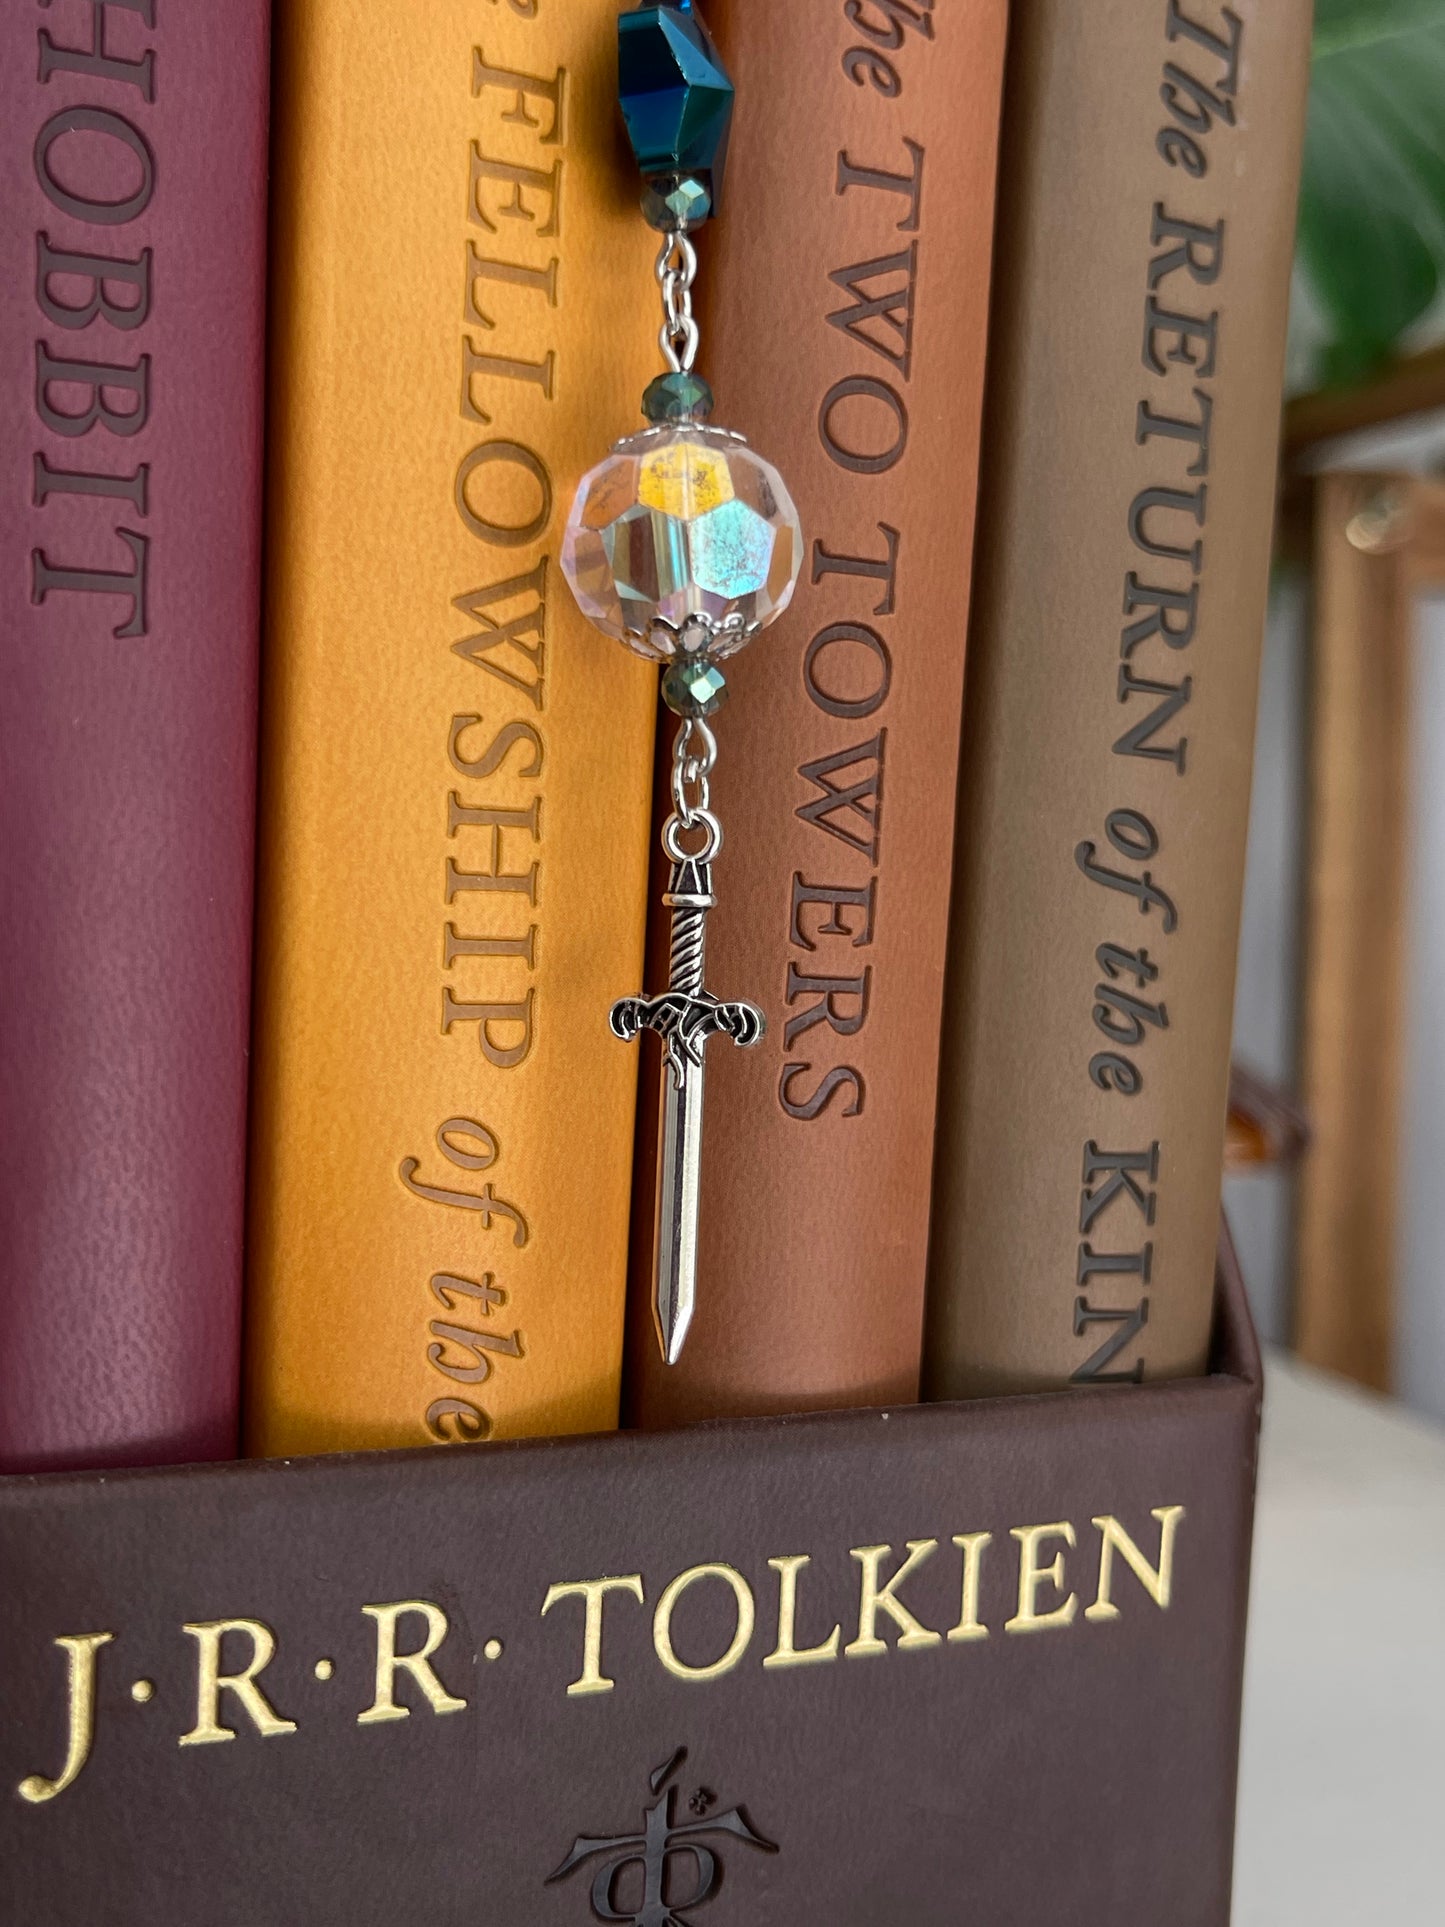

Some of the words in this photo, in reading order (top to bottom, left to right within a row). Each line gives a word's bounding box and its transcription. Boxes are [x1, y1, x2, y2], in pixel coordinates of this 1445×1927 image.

[841, 0, 935, 97] he
[1155, 0, 1243, 179] The
[33, 0, 156, 638] HOBBIT
[817, 136, 925, 474] TWO
[440, 45, 566, 1068] FELLOWSHIP
[1112, 202, 1225, 775] RETURN
[777, 521, 900, 1121] TOWERS
[1075, 807, 1178, 934] of
[1089, 942, 1170, 1096] the
[400, 1116, 527, 1248] of
[426, 1271, 525, 1441] the
[540, 1505, 1185, 1696] TOLKIEN
